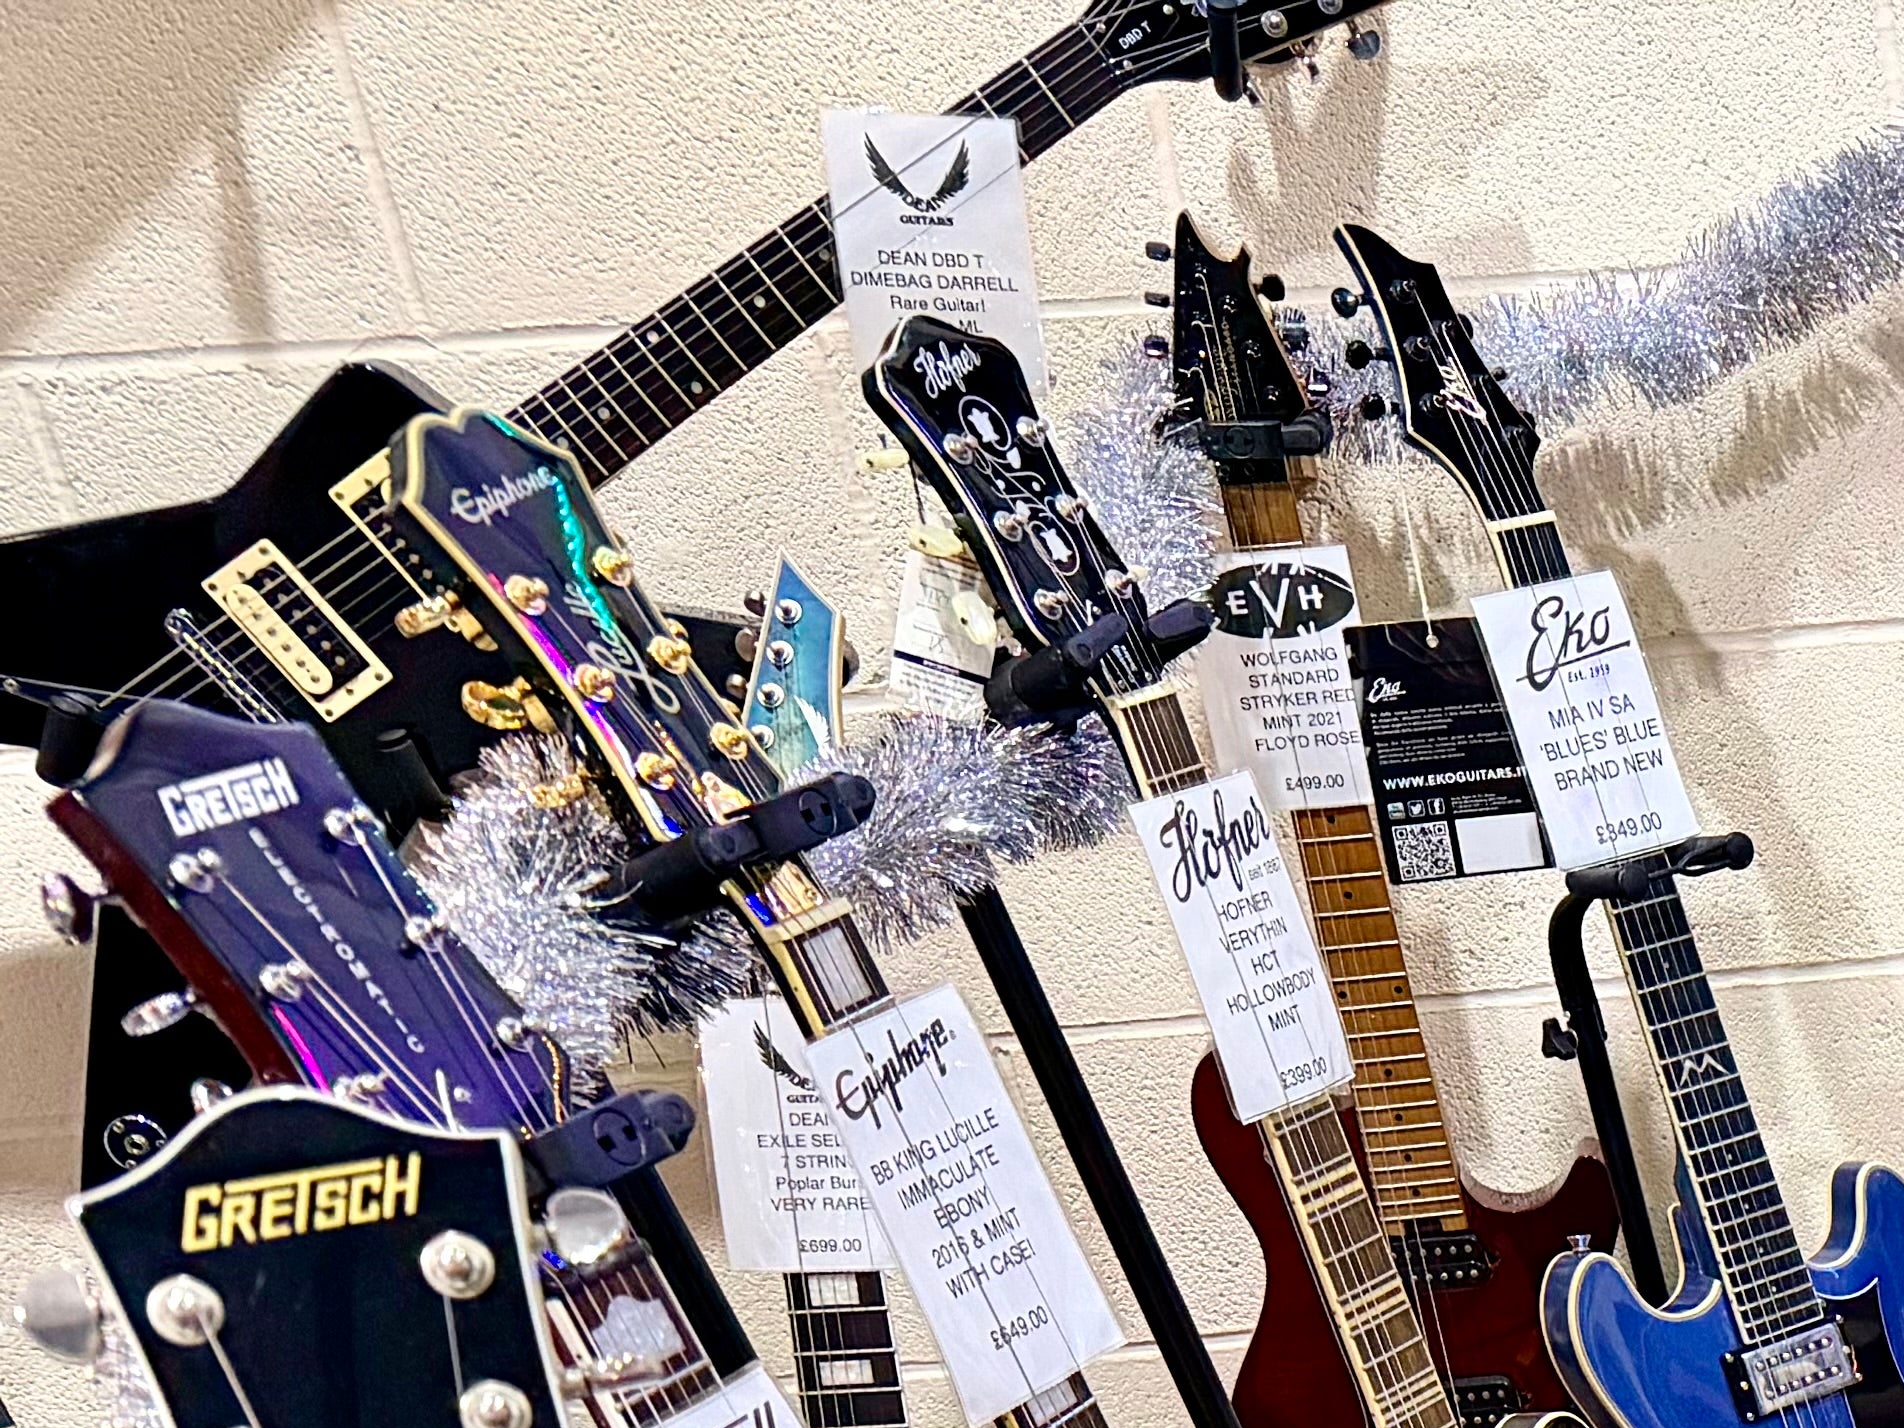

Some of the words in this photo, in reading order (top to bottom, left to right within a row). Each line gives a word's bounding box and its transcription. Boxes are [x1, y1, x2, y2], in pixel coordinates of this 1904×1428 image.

[878, 250, 927, 267] DEAN
[932, 251, 970, 268] DBD
[974, 253, 985, 268] T
[851, 271, 933, 291] DIMEBAG
[937, 274, 1019, 293] DARRELL
[891, 295, 929, 311] Rare
[451, 466, 556, 526] Epiphone
[1225, 577, 1324, 630] EVH
[1241, 647, 1338, 667] WOLFGANG
[1516, 595, 1631, 692] Eko
[1249, 668, 1339, 688] STANDARD
[1240, 690, 1318, 711] STRYKER
[1323, 688, 1356, 703] RED
[1549, 705, 1585, 729] MIA
[1588, 699, 1604, 720] IV
[1610, 694, 1636, 716] SA
[1263, 714, 1301, 730] MINT
[1308, 711, 1343, 727] 2021
[1613, 718, 1661, 746] BLUE
[1255, 734, 1310, 752] FLOYD
[1315, 731, 1361, 747] ROSE
[1286, 774, 1345, 791] £499.00
[1554, 759, 1620, 791] BRAND
[1623, 749, 1664, 773] NEW
[158, 756, 300, 837] GRETSCH
[1219, 917, 1289, 954] VERYTHIN
[1250, 950, 1282, 976] HCT
[1226, 968, 1317, 1016] HOLLOWBODY
[1268, 1003, 1303, 1032] MINT
[836, 1018, 951, 1130] Epiphone
[870, 1156, 894, 1187] BB
[895, 1136, 937, 1175] KING
[939, 1106, 1001, 1156] LUCILLE
[776, 1176, 825, 1193] Poplar
[898, 1144, 1002, 1210] IMMACULATE
[181, 1151, 422, 1254] GRETSCH
[771, 1196, 817, 1212] VERY
[822, 1196, 870, 1212] RARE
[933, 1187, 992, 1229] EBONY
[971, 1226, 986, 1247] &
[985, 1207, 1024, 1240] MINT
[946, 1263, 990, 1299] WITH
